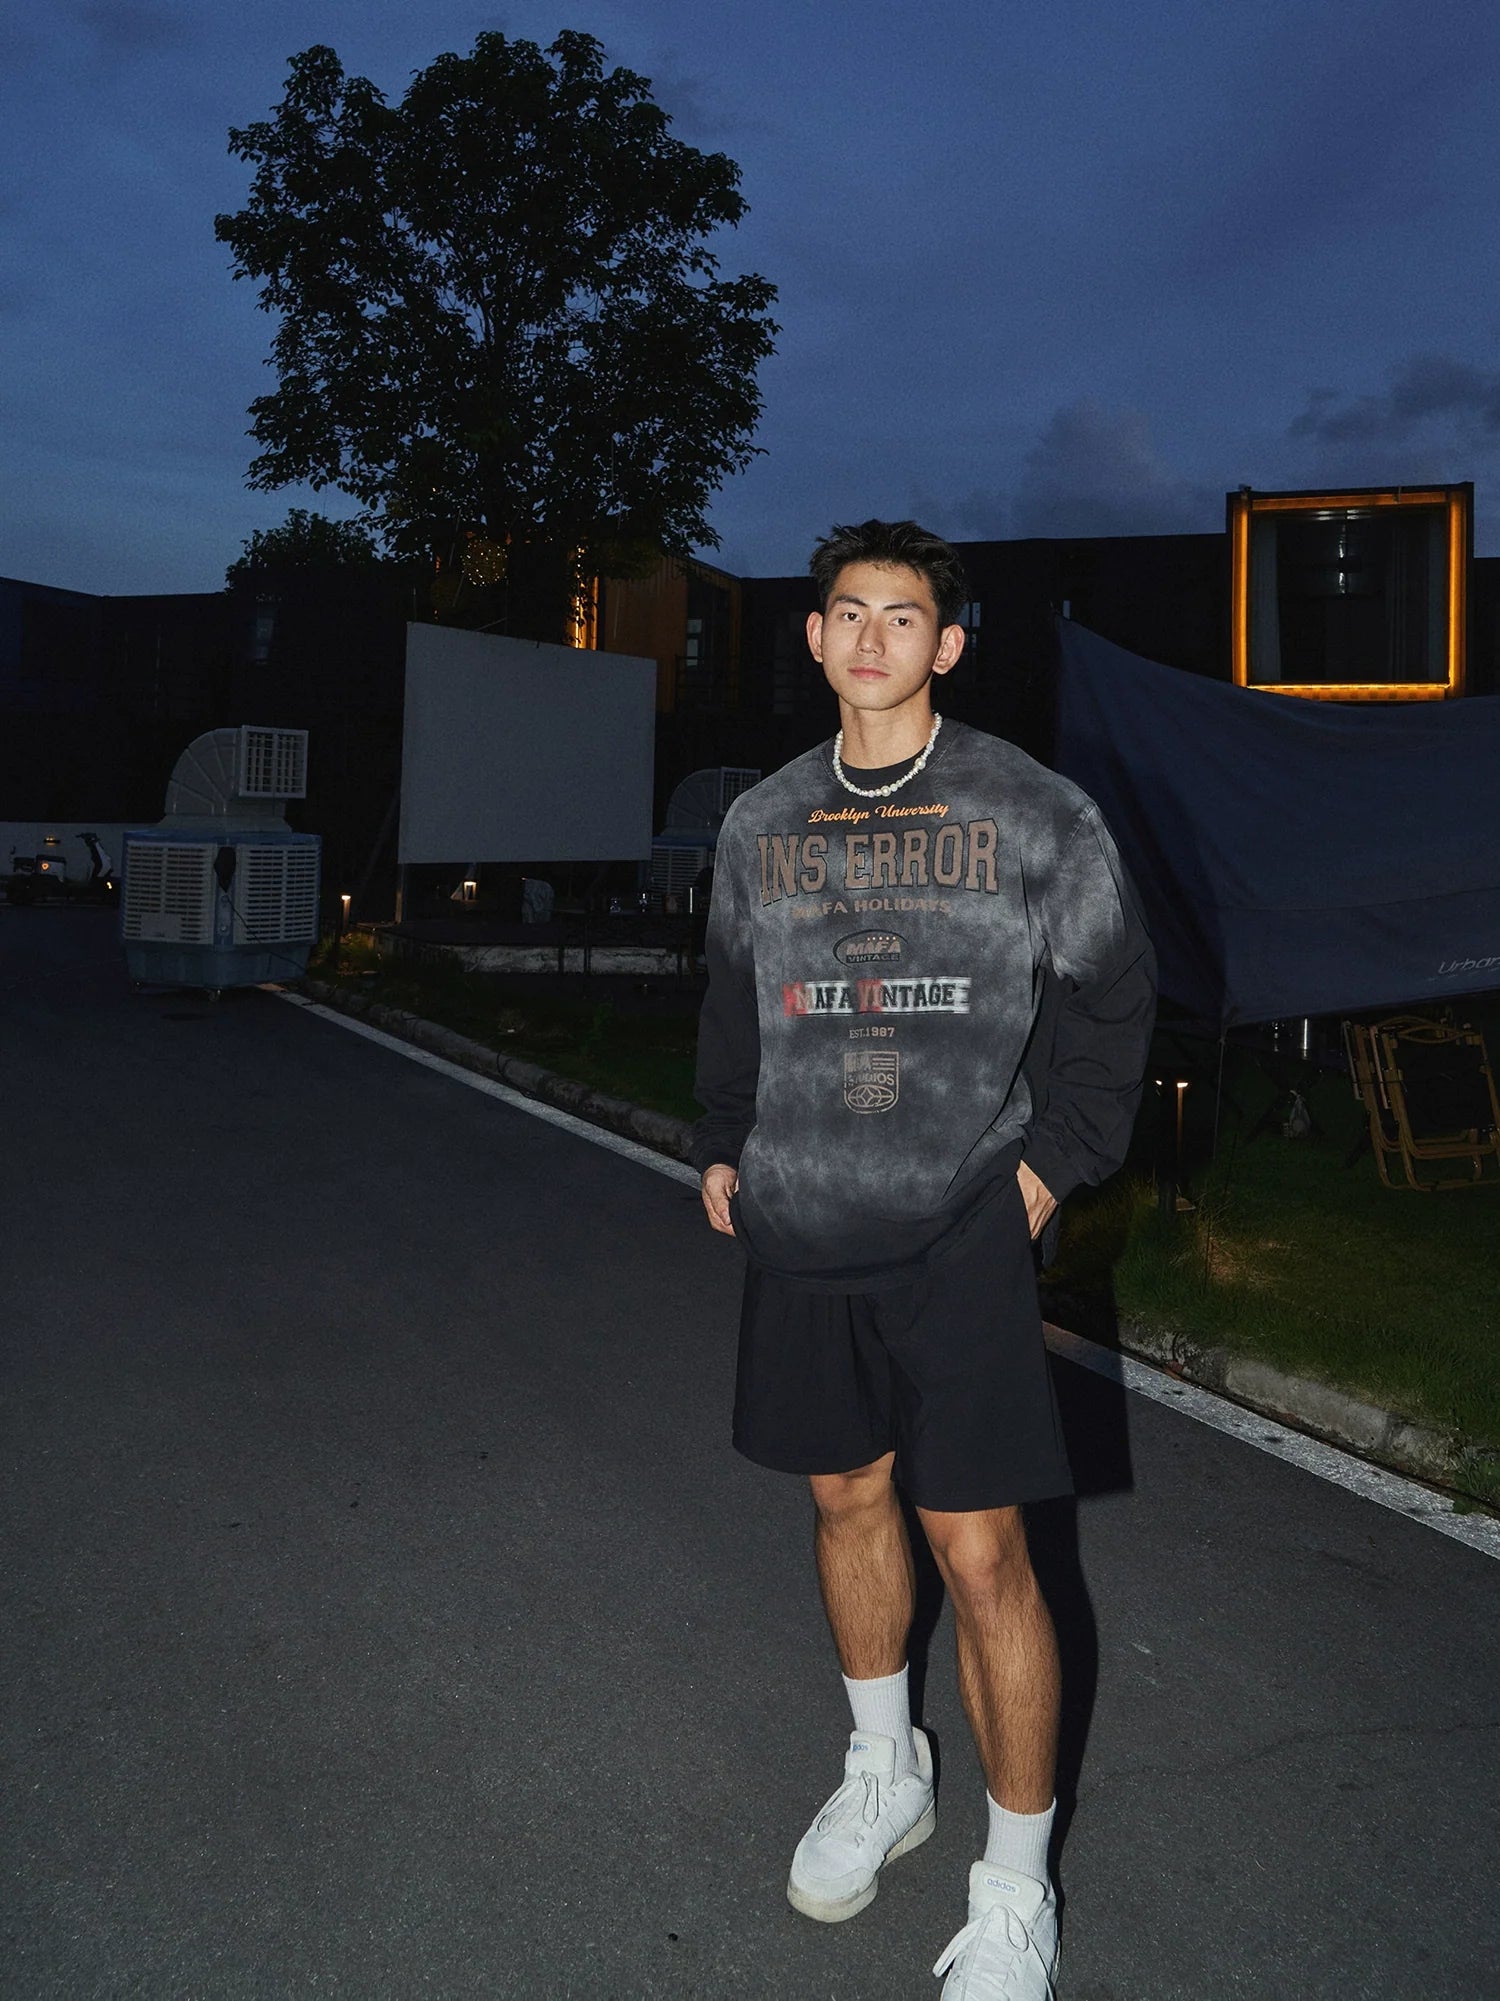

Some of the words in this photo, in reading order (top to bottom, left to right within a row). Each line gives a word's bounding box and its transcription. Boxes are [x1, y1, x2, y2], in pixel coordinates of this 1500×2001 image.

[807, 807, 871, 825] Brooklyn
[874, 803, 950, 819] University
[757, 832, 829, 907] INS
[844, 817, 999, 895] ERROR
[847, 953, 900, 963] VINTAGE
[793, 985, 853, 1010] MAFA
[857, 983, 957, 1010] VINTAGE
[986, 1878, 1017, 1893] adidas
